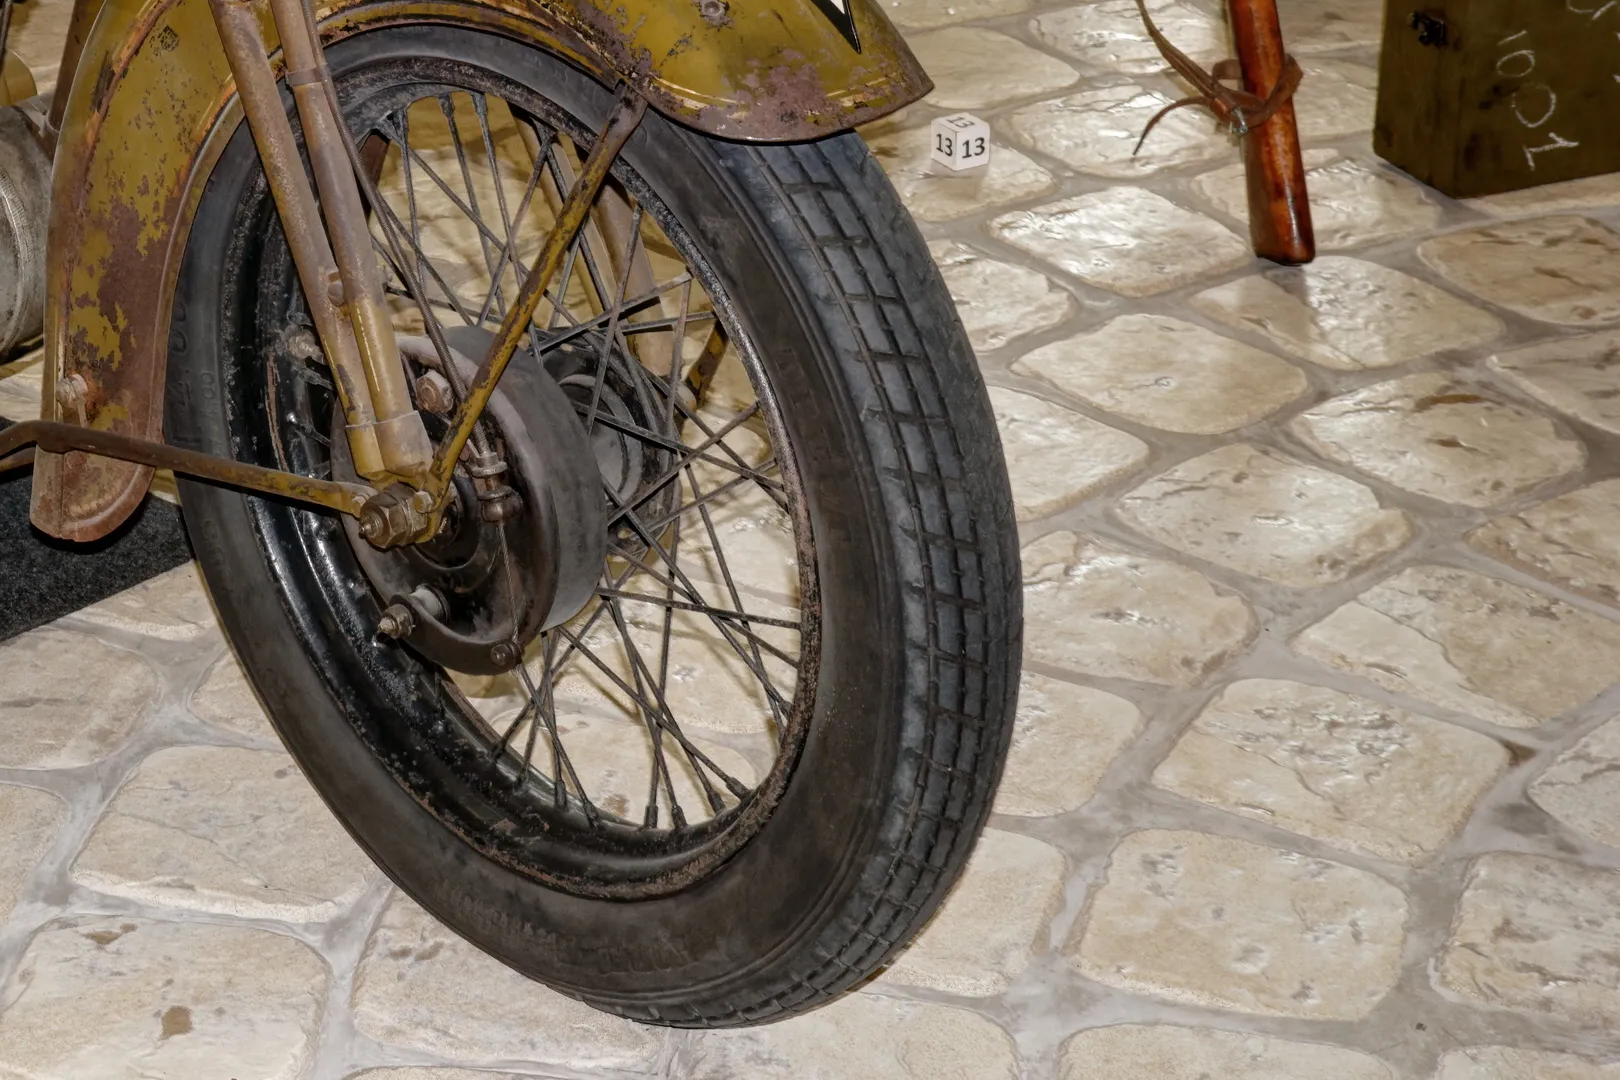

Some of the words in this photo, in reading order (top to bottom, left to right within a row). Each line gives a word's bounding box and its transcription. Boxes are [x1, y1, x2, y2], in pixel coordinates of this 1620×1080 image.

[945, 116, 975, 129] 13
[935, 133, 953, 158] 13
[961, 136, 986, 159] 13
